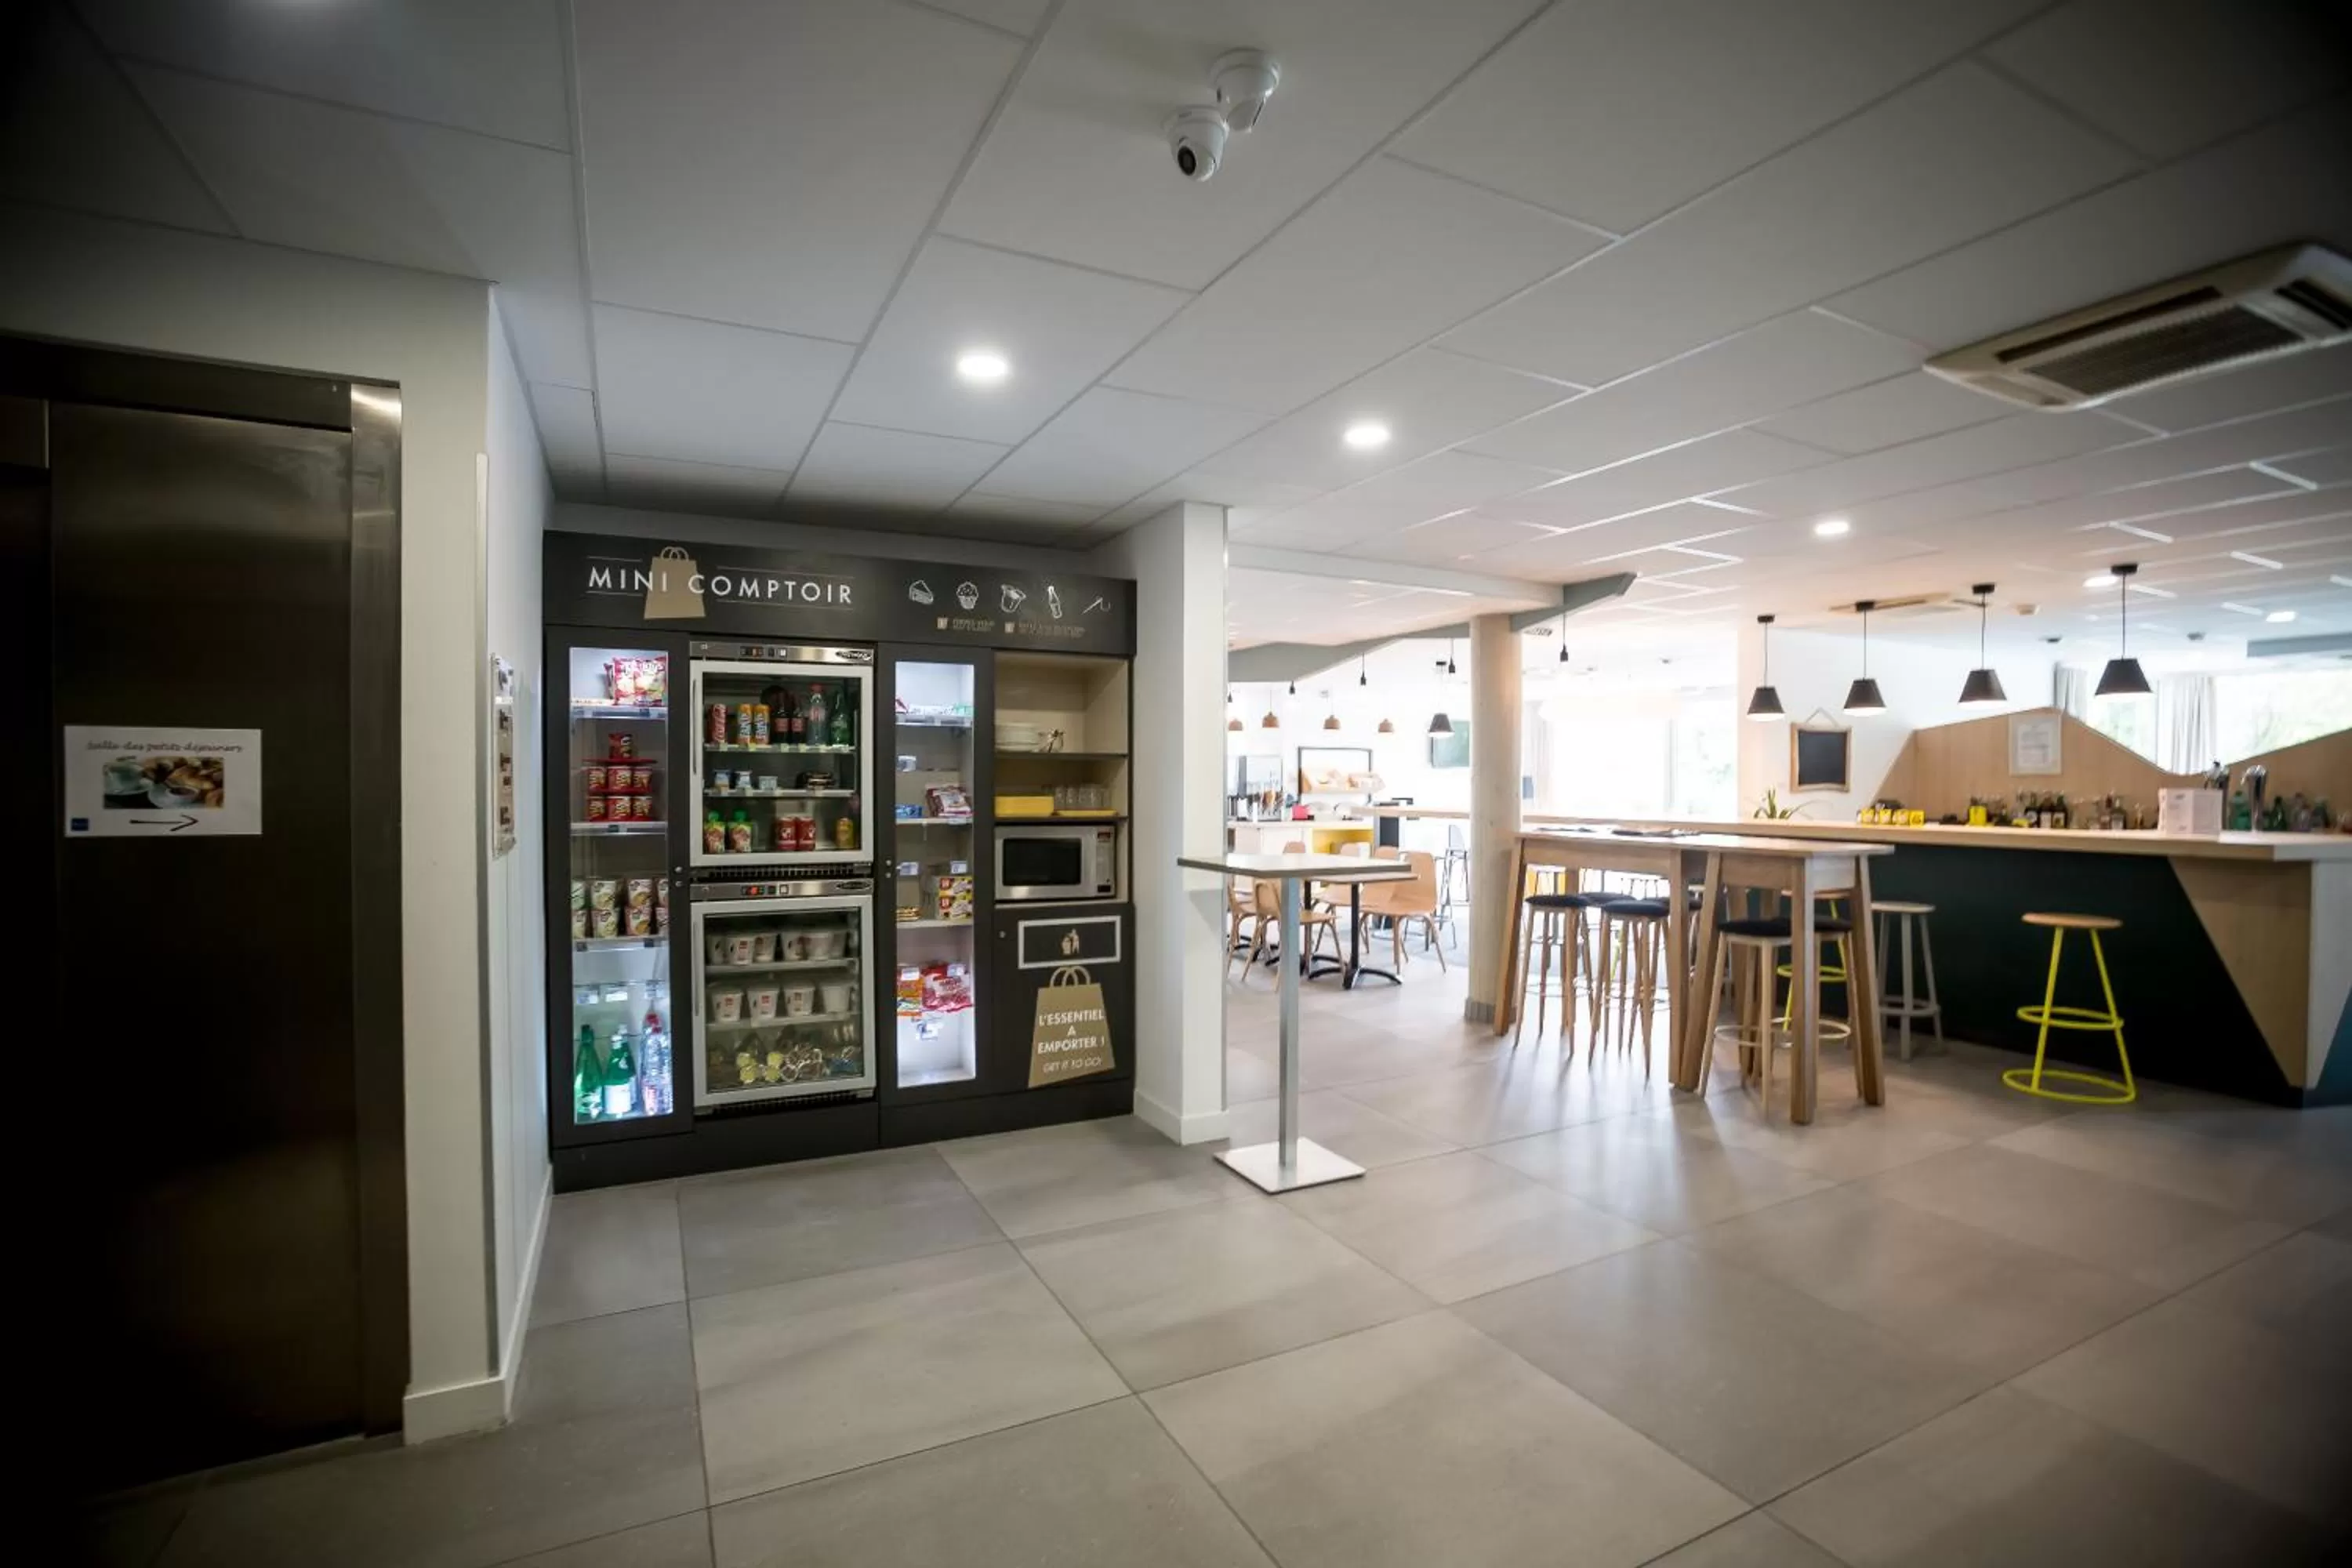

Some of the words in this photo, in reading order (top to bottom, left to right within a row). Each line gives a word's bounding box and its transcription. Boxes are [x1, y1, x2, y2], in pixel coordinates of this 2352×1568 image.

[589, 566, 666, 593] MINI
[688, 574, 852, 604] COMPTOIR
[1039, 1008, 1104, 1027] L'ESSENTIEL
[1037, 1036, 1097, 1054] EMPORTER
